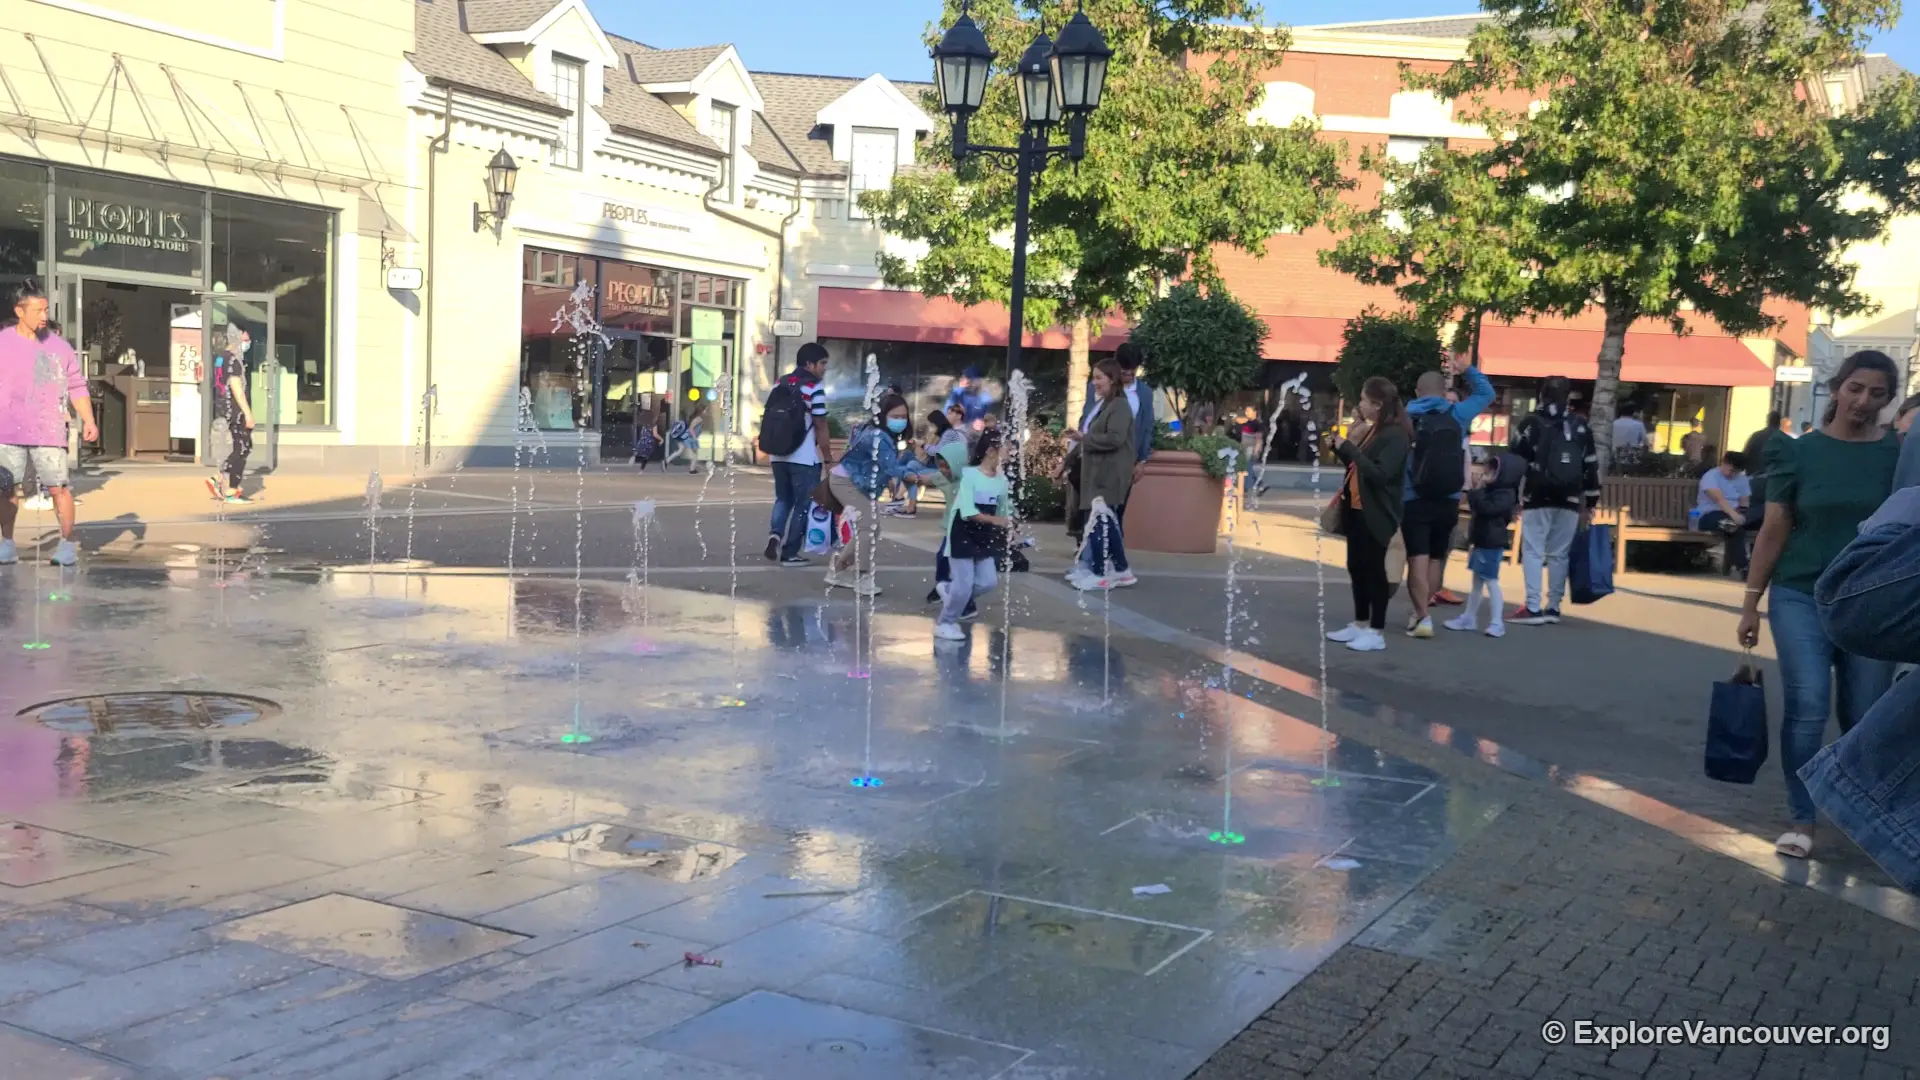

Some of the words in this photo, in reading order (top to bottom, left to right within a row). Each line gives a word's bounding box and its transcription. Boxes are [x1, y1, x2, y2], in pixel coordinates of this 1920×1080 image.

[68, 195, 188, 240] PEOPLES
[602, 202, 648, 225] PEOPLES
[68, 228, 93, 240] THE
[95, 231, 151, 248] DIAMOND
[153, 239, 189, 253] STORE
[607, 280, 670, 309] PEOPLES
[179, 345, 197, 359] 25
